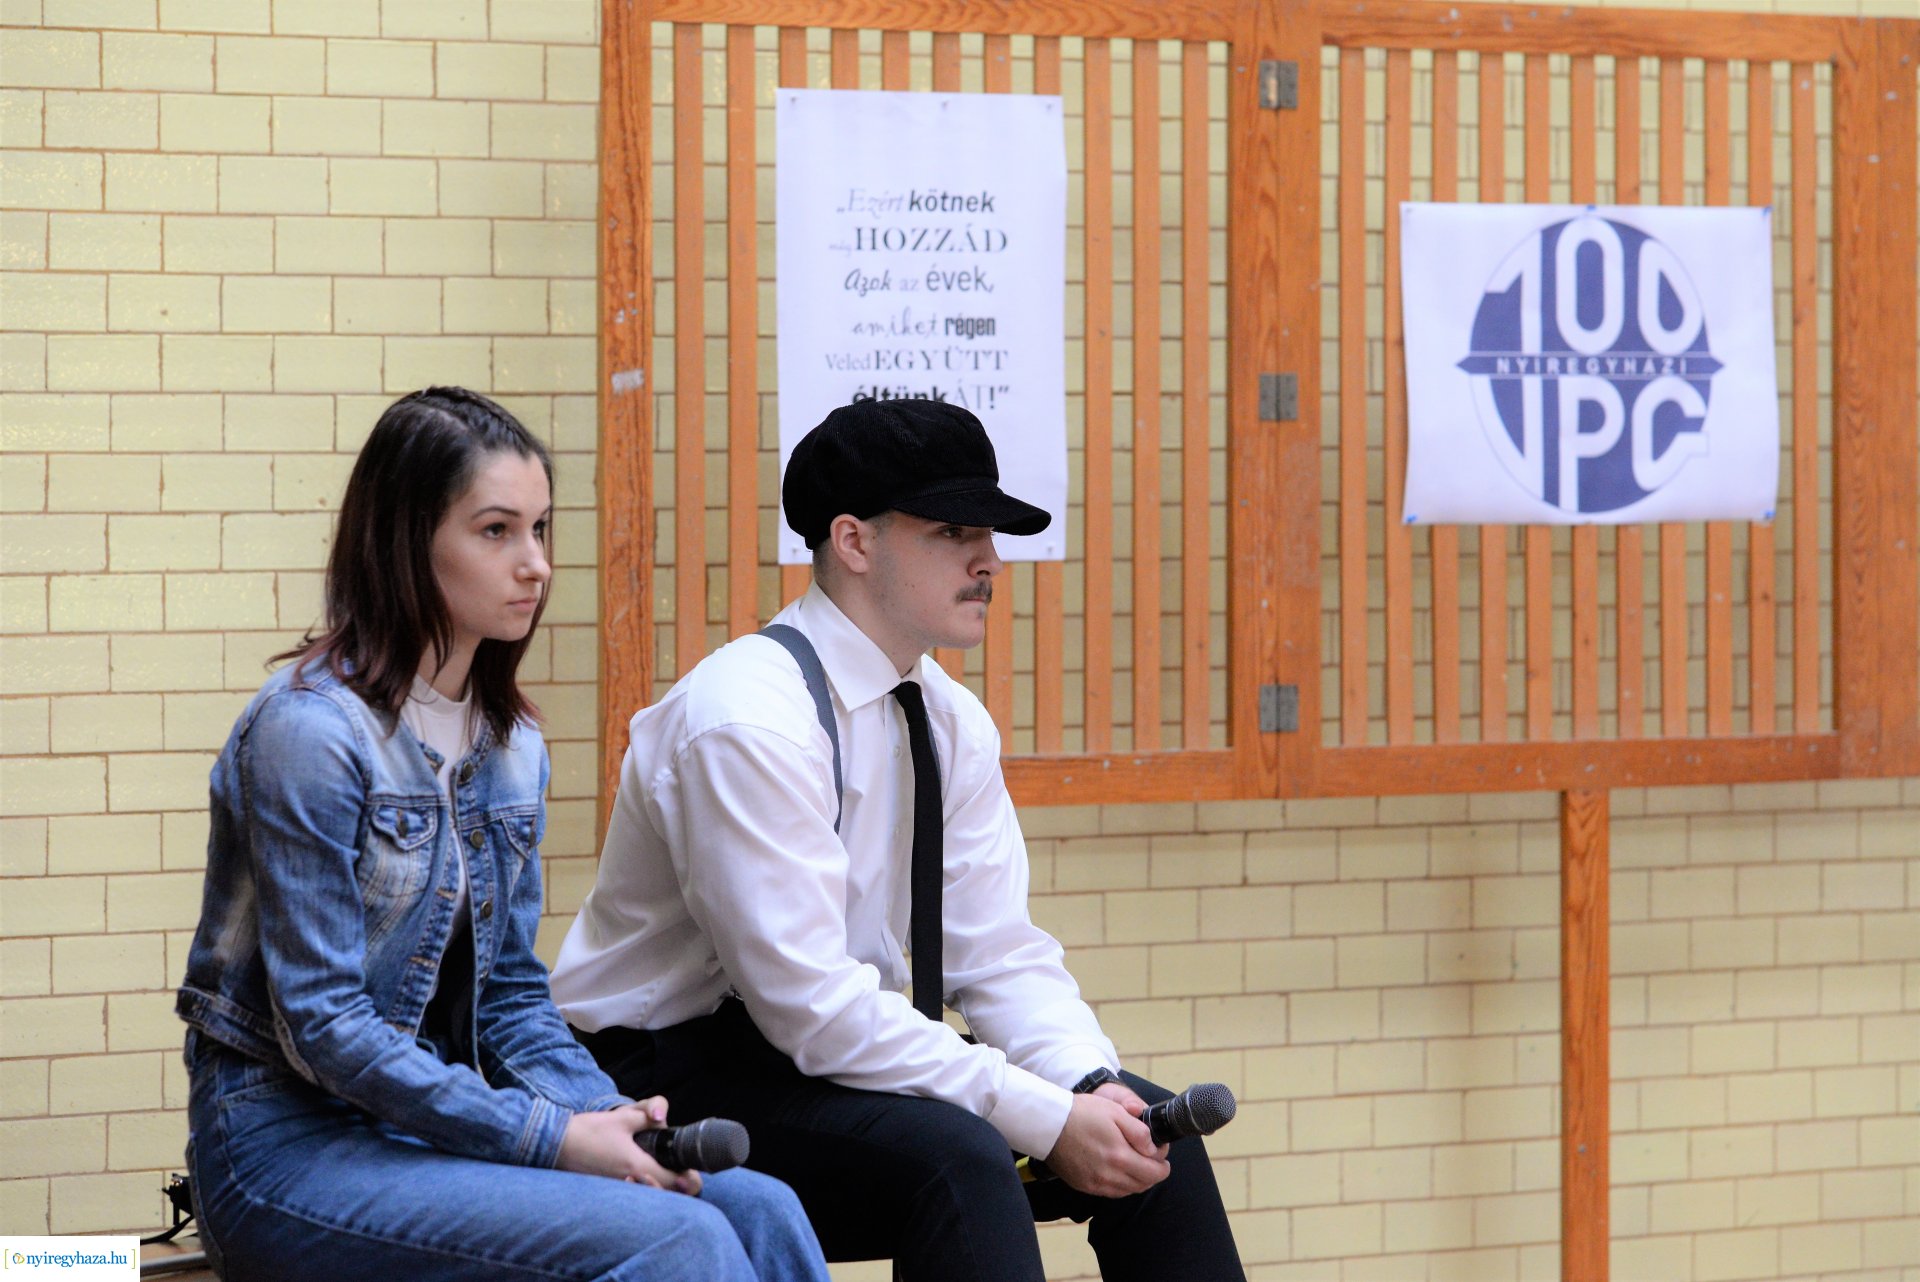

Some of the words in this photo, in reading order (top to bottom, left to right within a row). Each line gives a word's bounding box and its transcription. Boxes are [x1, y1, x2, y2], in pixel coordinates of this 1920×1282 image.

[909, 189, 995, 212] kötnek
[855, 223, 1008, 252] HOZZÁD
[844, 268, 891, 297] Azok
[900, 278, 919, 291] az
[926, 264, 994, 293] évek,
[1484, 217, 1704, 355] 100
[852, 306, 938, 338] amiket
[945, 314, 996, 339] régen
[825, 353, 871, 371] Veled
[873, 345, 1008, 371] EGYÜTT
